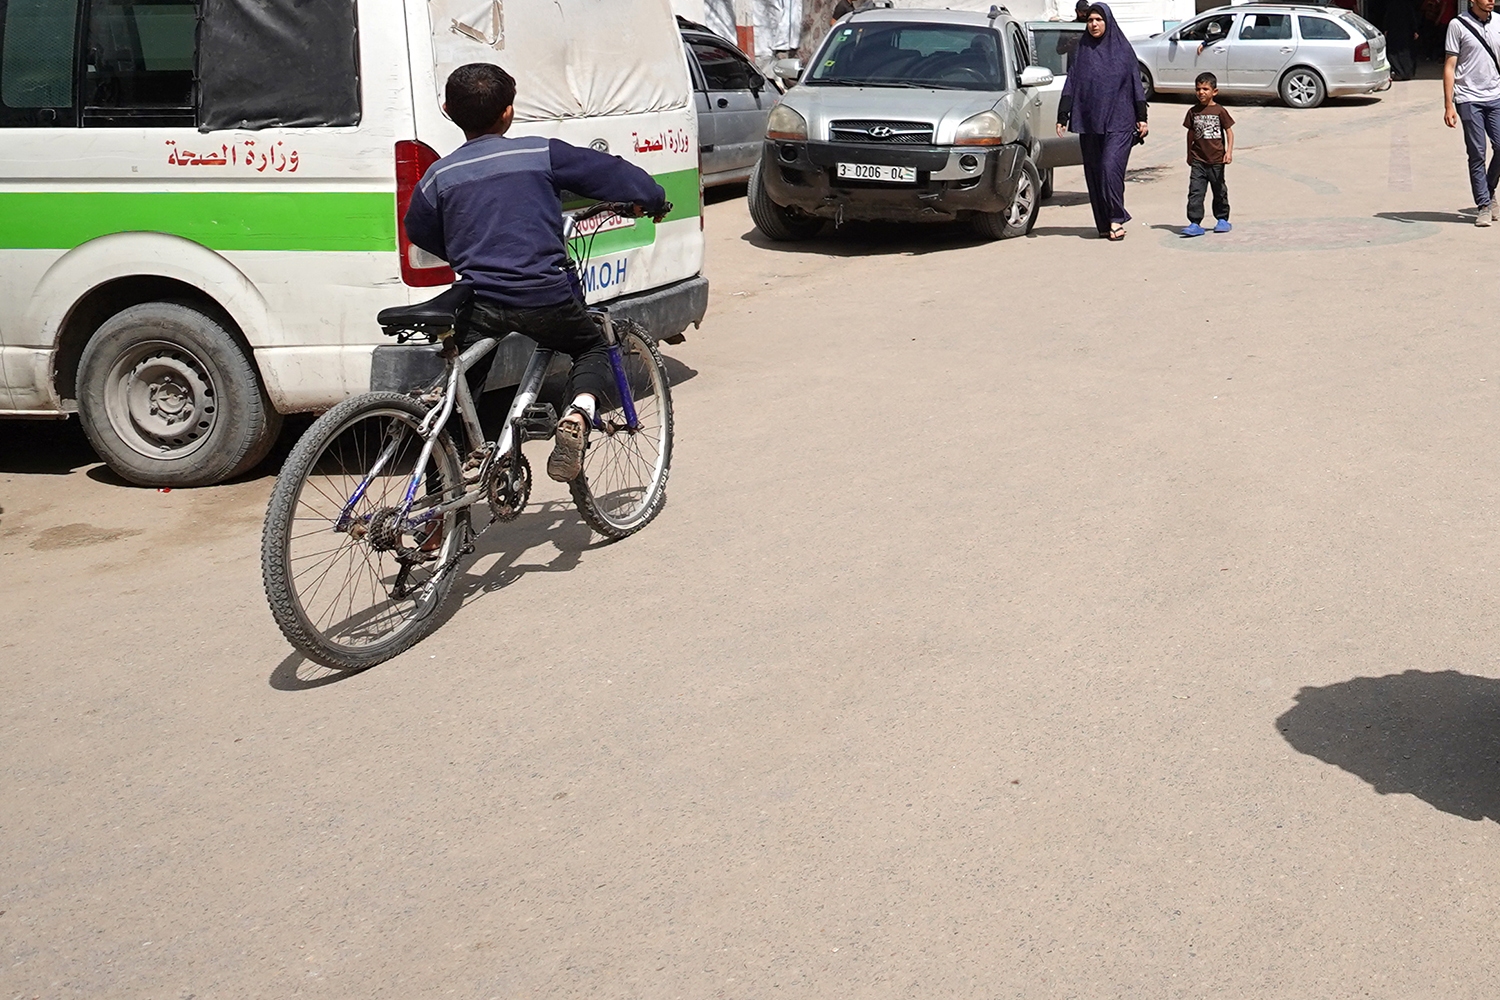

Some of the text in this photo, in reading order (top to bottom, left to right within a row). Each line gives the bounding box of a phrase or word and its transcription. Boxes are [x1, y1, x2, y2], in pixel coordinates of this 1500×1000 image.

[165, 140, 299, 172] وزارة الصحة
[632, 128, 689, 154] وزارة الصحة
[583, 257, 628, 293] M.O.H
